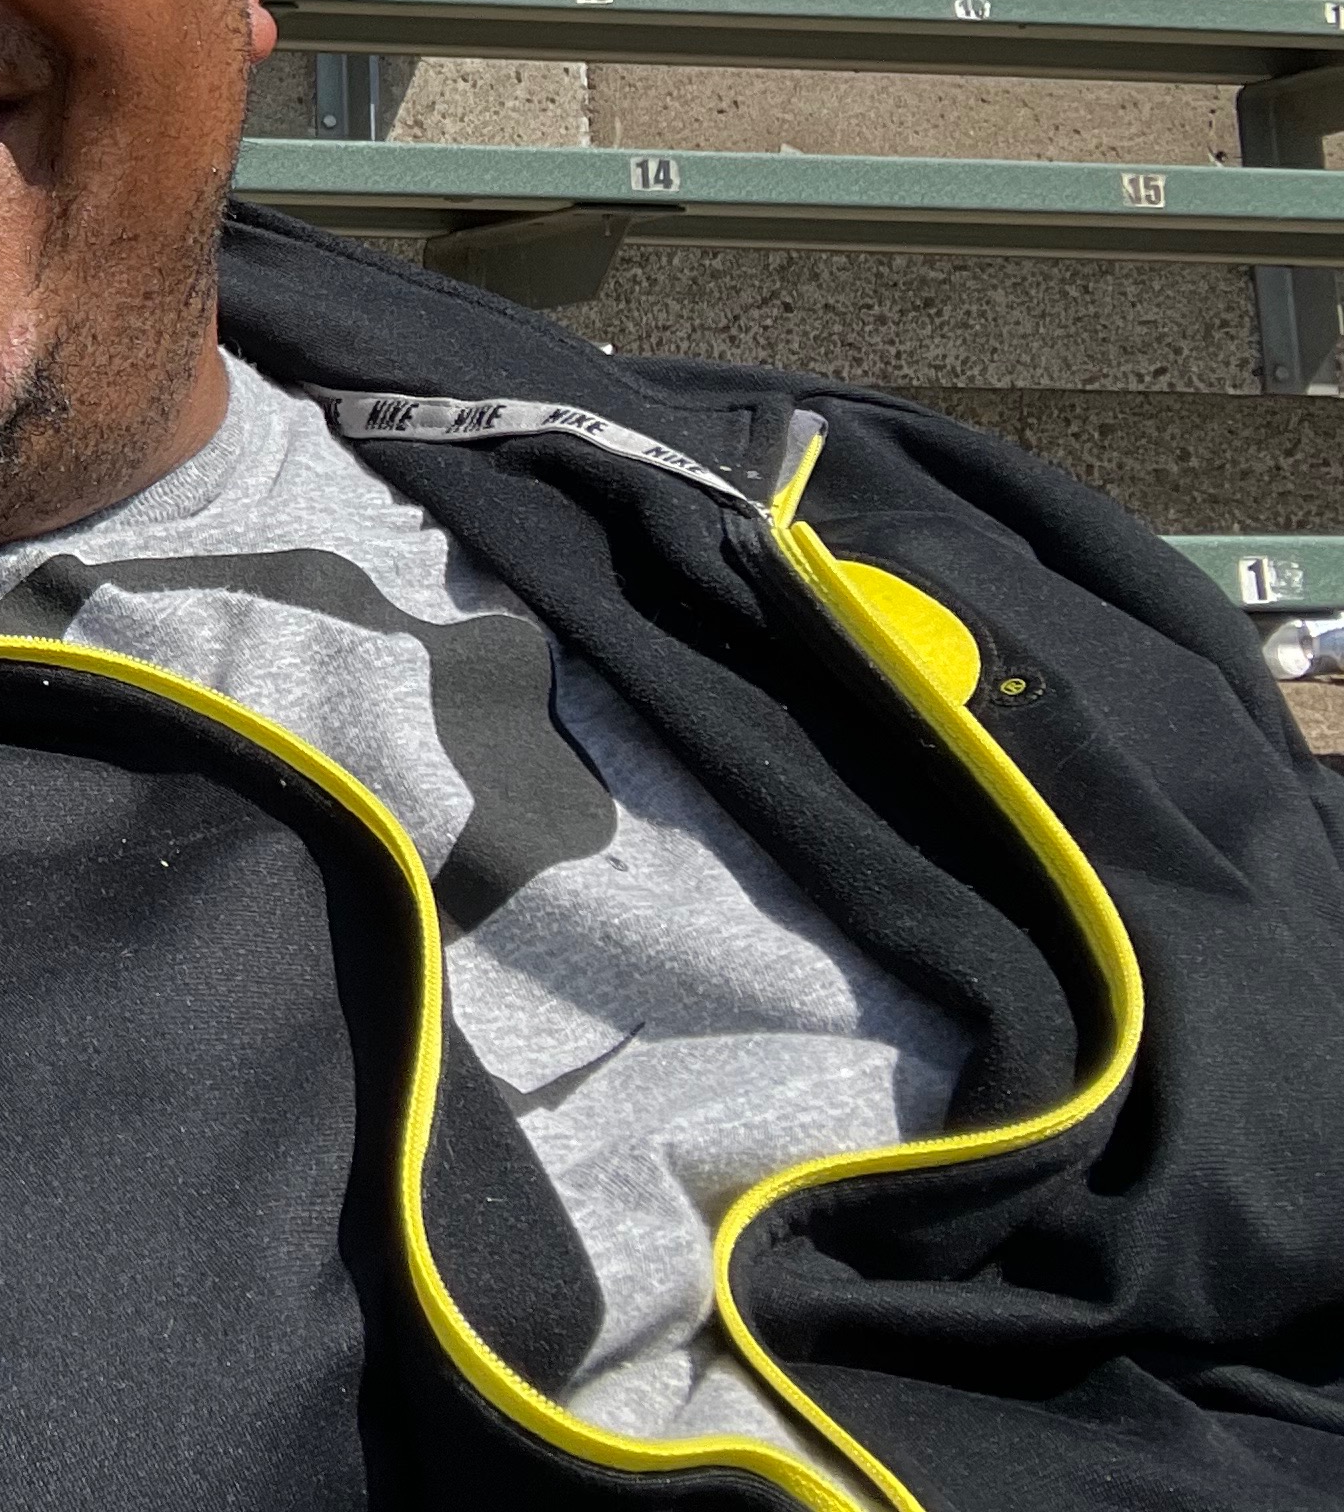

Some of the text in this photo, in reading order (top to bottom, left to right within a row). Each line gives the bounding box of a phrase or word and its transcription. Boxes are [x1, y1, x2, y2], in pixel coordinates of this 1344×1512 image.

[635, 159, 673, 189] 14
[1129, 176, 1162, 205] 15
[366, 399, 419, 431] NIKE
[445, 404, 507, 434] NIKE
[541, 408, 609, 436] NIKE
[641, 445, 708, 475] NIKE
